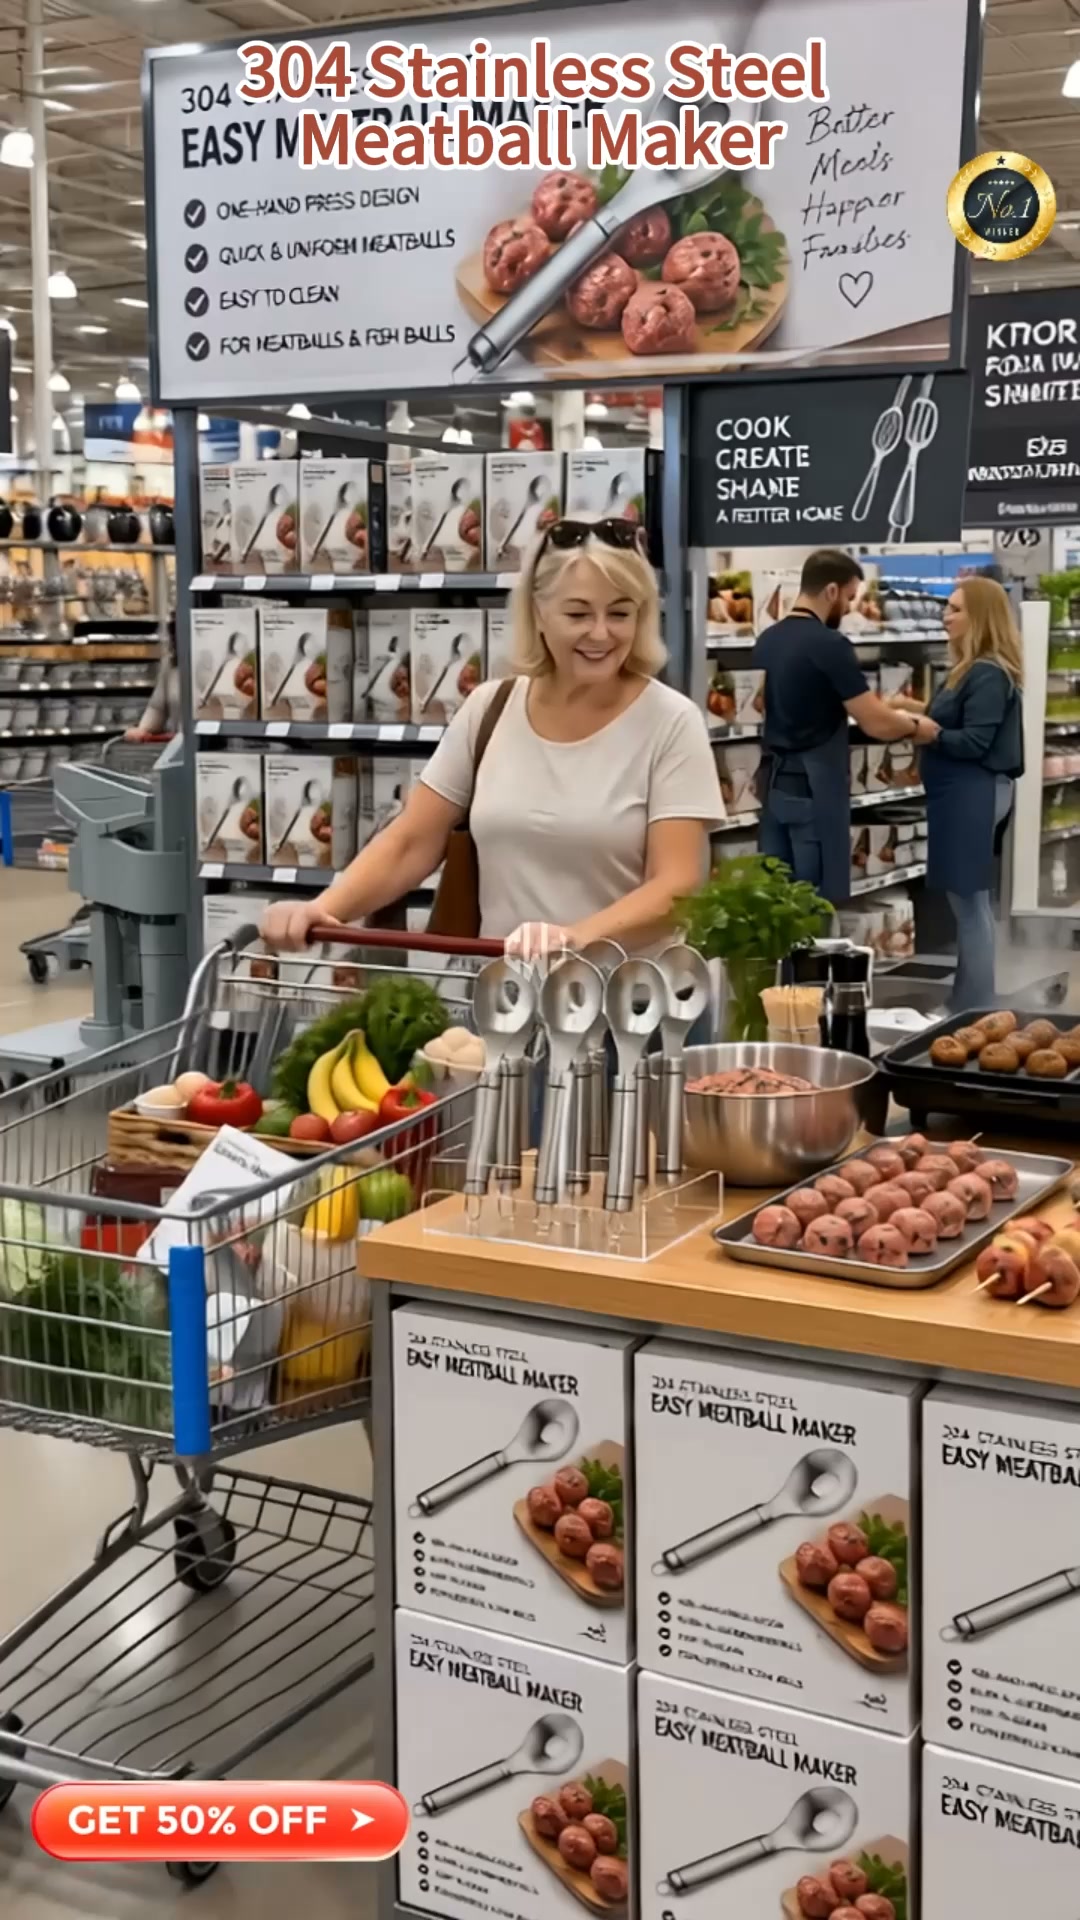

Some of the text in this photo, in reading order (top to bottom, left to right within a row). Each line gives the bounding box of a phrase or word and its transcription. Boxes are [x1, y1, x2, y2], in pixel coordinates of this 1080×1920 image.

[181, 82, 232, 114] 304
[181, 119, 266, 169] EASY
[716, 415, 792, 441] COOK
[715, 445, 811, 470] CREATE
[942, 1443, 990, 1472] EASY
[995, 1453, 1080, 1488] MEATBA
[994, 1807, 1080, 1850] MEATBA
